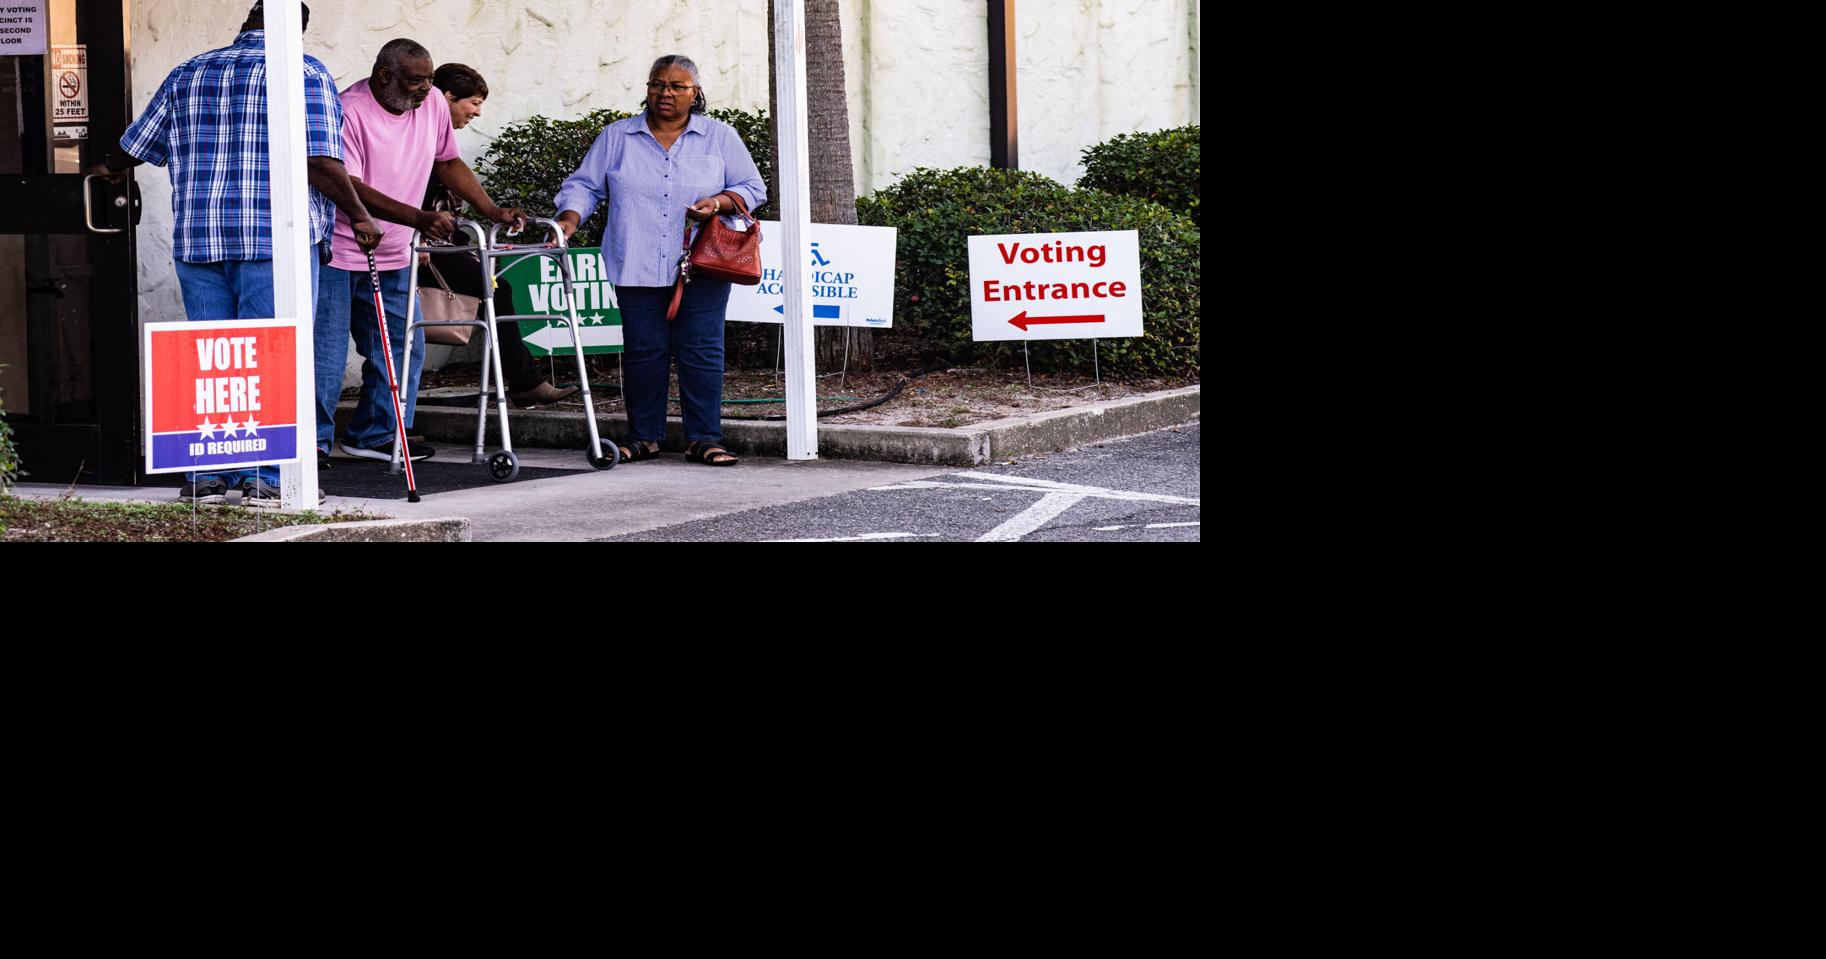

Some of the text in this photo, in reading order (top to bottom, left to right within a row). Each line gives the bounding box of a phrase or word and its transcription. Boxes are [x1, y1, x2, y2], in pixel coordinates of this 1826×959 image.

[63, 53, 86, 65] SMOKING
[66, 108, 86, 116] FEET
[997, 240, 1106, 268] Voting
[540, 253, 608, 283] EAR
[763, 269, 855, 284] HAICAP
[528, 281, 620, 312] VOTIN
[756, 283, 858, 299] ACSIBLE
[983, 280, 1127, 302] Entrance
[196, 336, 258, 371] VOTE
[195, 376, 261, 414] HERE
[189, 439, 267, 456] ID REQUIRED
